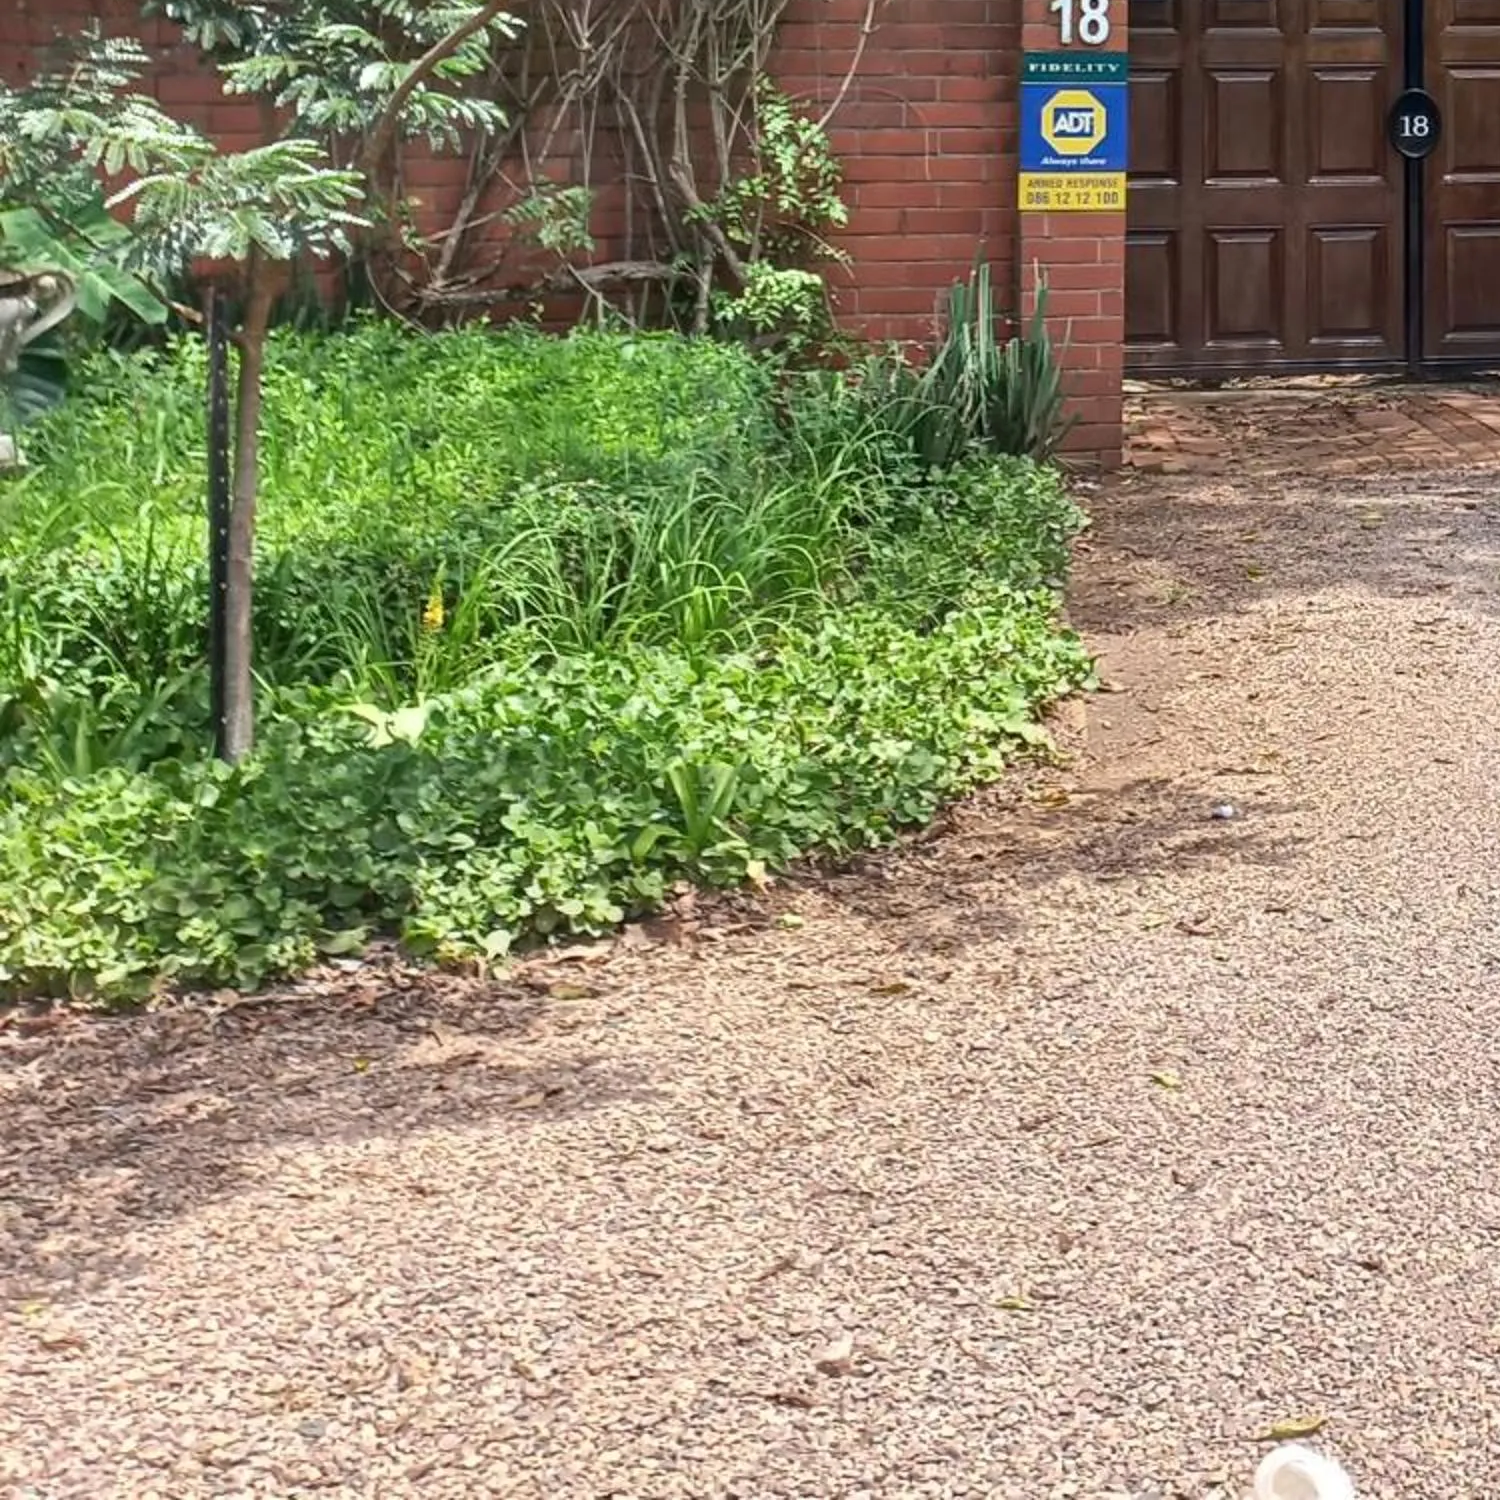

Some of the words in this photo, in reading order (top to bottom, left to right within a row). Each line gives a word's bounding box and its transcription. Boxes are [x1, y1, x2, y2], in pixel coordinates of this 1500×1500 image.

[1028, 63, 1120, 73] FIDELITY
[1054, 111, 1094, 134] ADT
[1400, 115, 1429, 137] 18
[1027, 179, 1062, 188] ARMED
[1066, 179, 1118, 188] RESPONSE
[1056, 192, 1070, 204] 12
[1076, 192, 1090, 204] 12
[1096, 192, 1119, 204] 100
